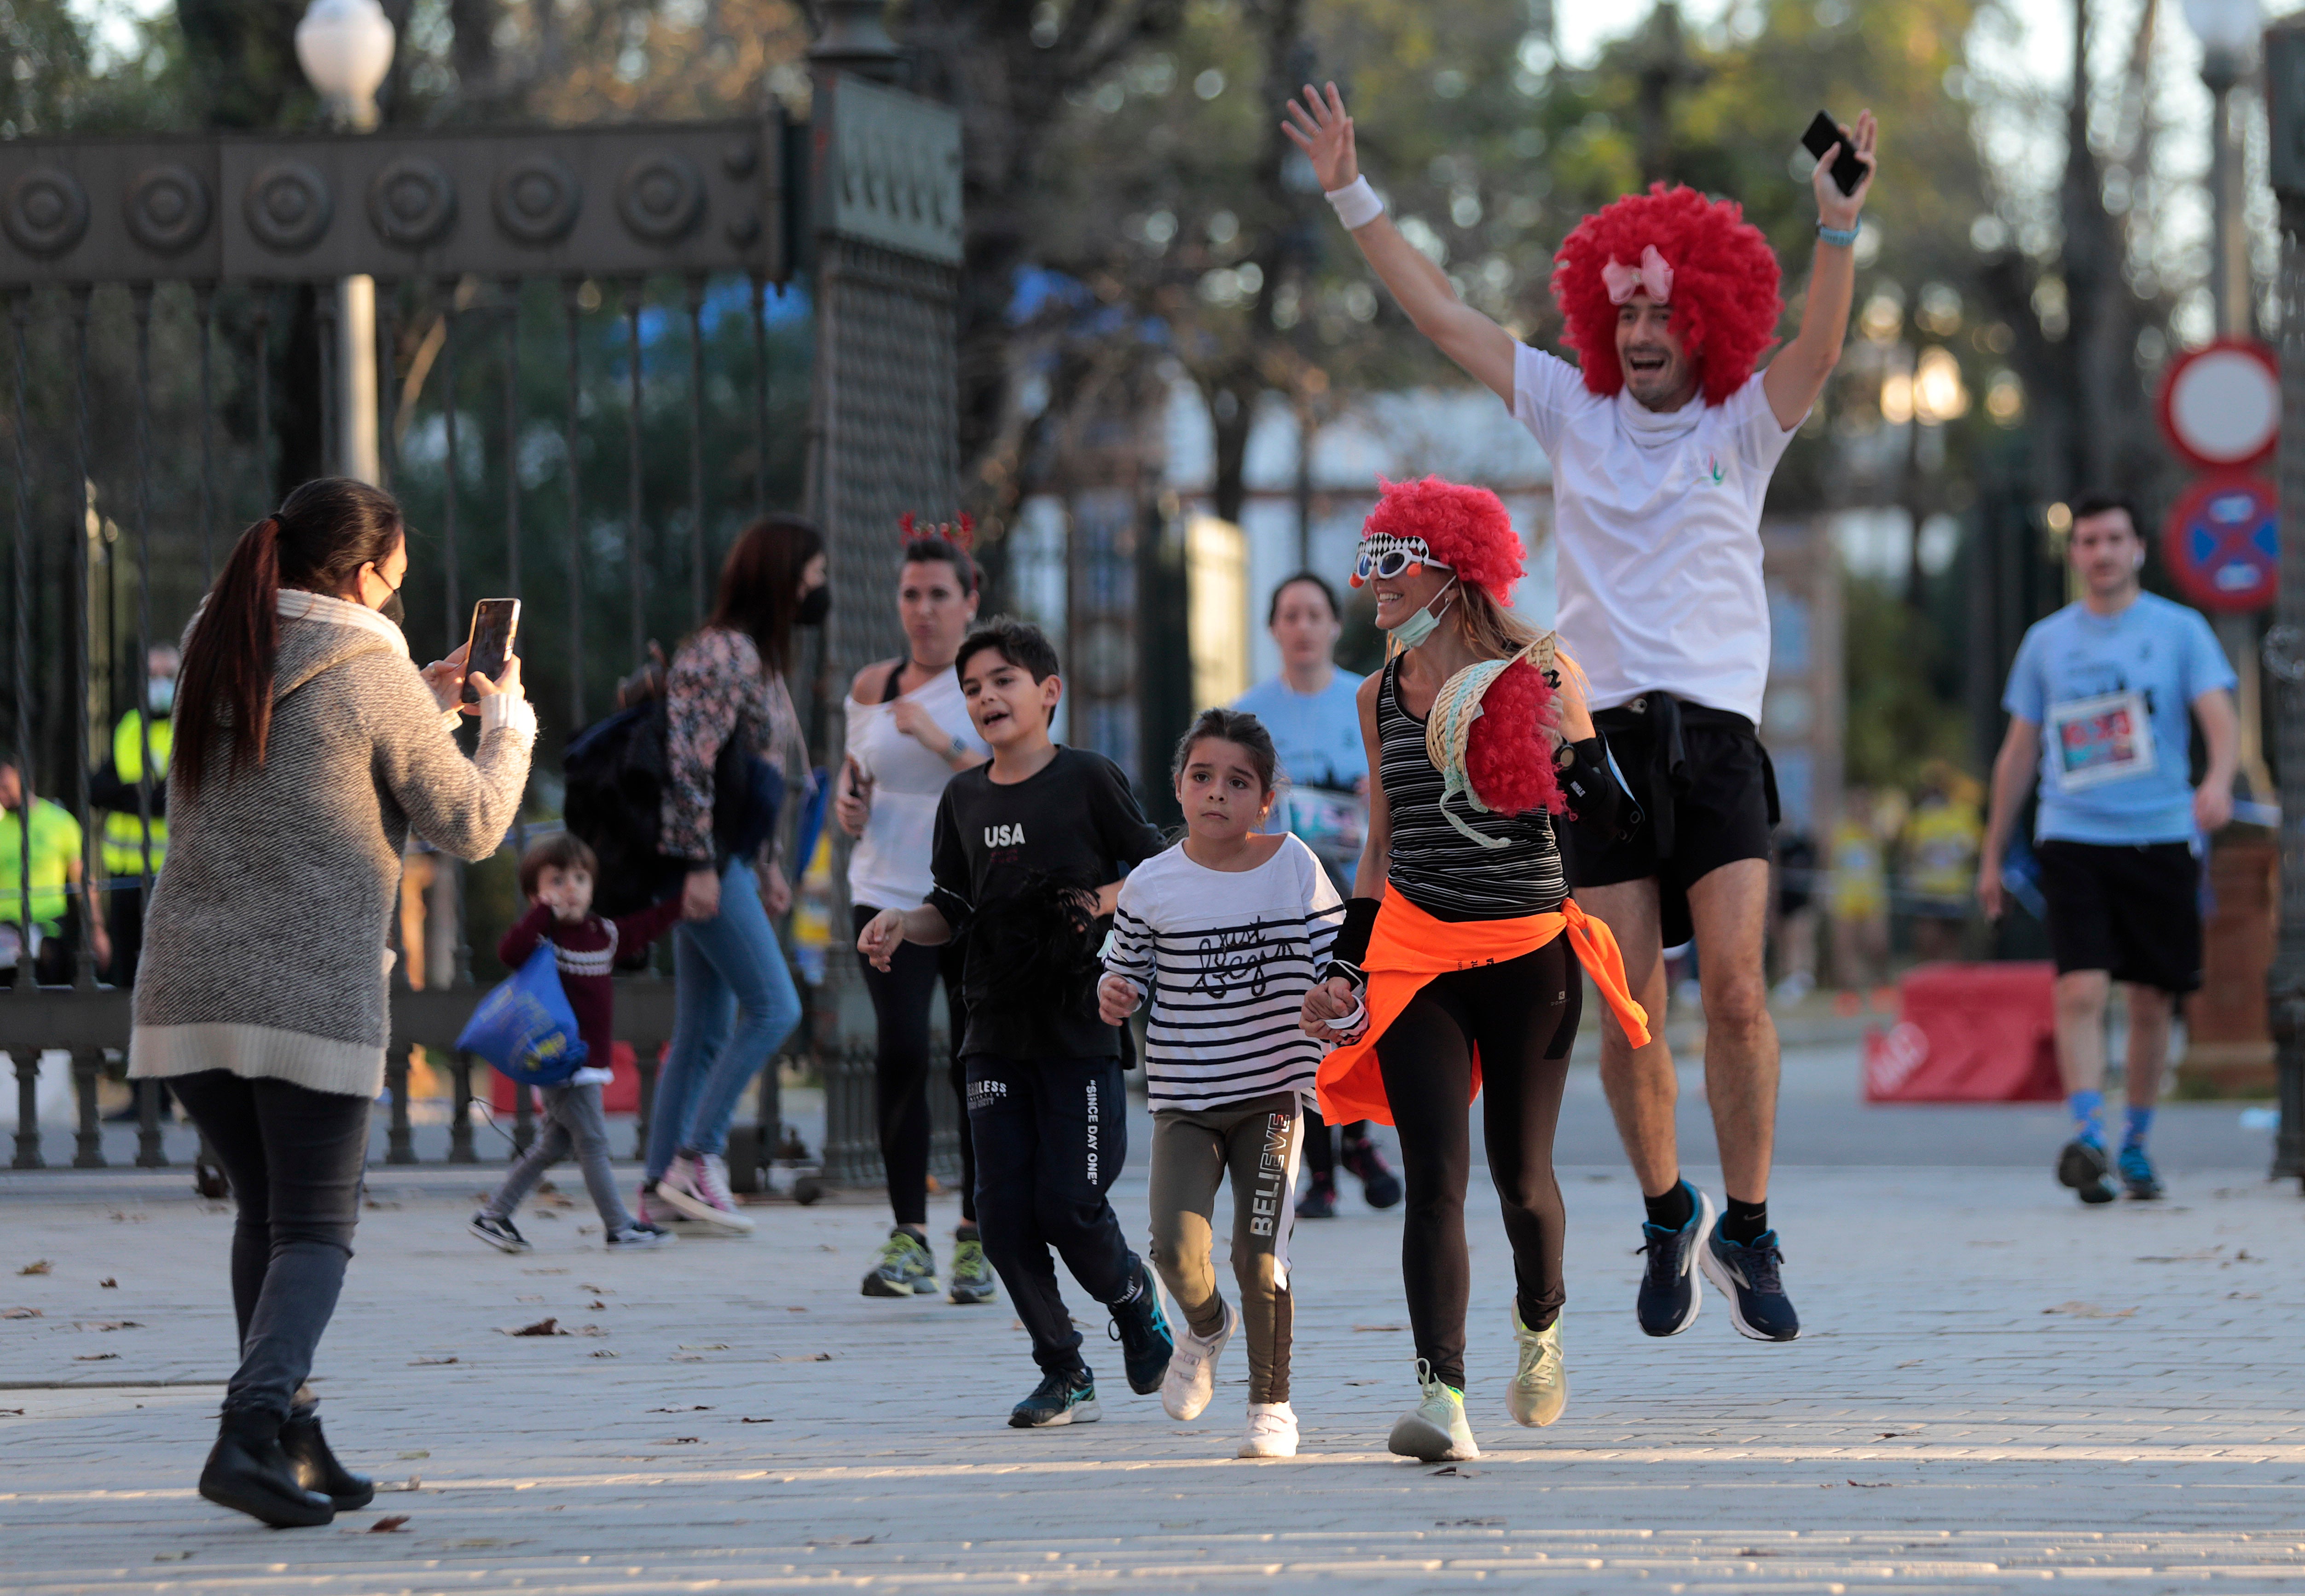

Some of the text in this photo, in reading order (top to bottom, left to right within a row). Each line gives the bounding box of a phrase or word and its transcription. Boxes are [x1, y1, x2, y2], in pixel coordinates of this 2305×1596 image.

[985, 823, 1025, 848] USA
[1087, 1126, 1098, 1151] DAY
[1250, 1113, 1290, 1236] BELIEVE
